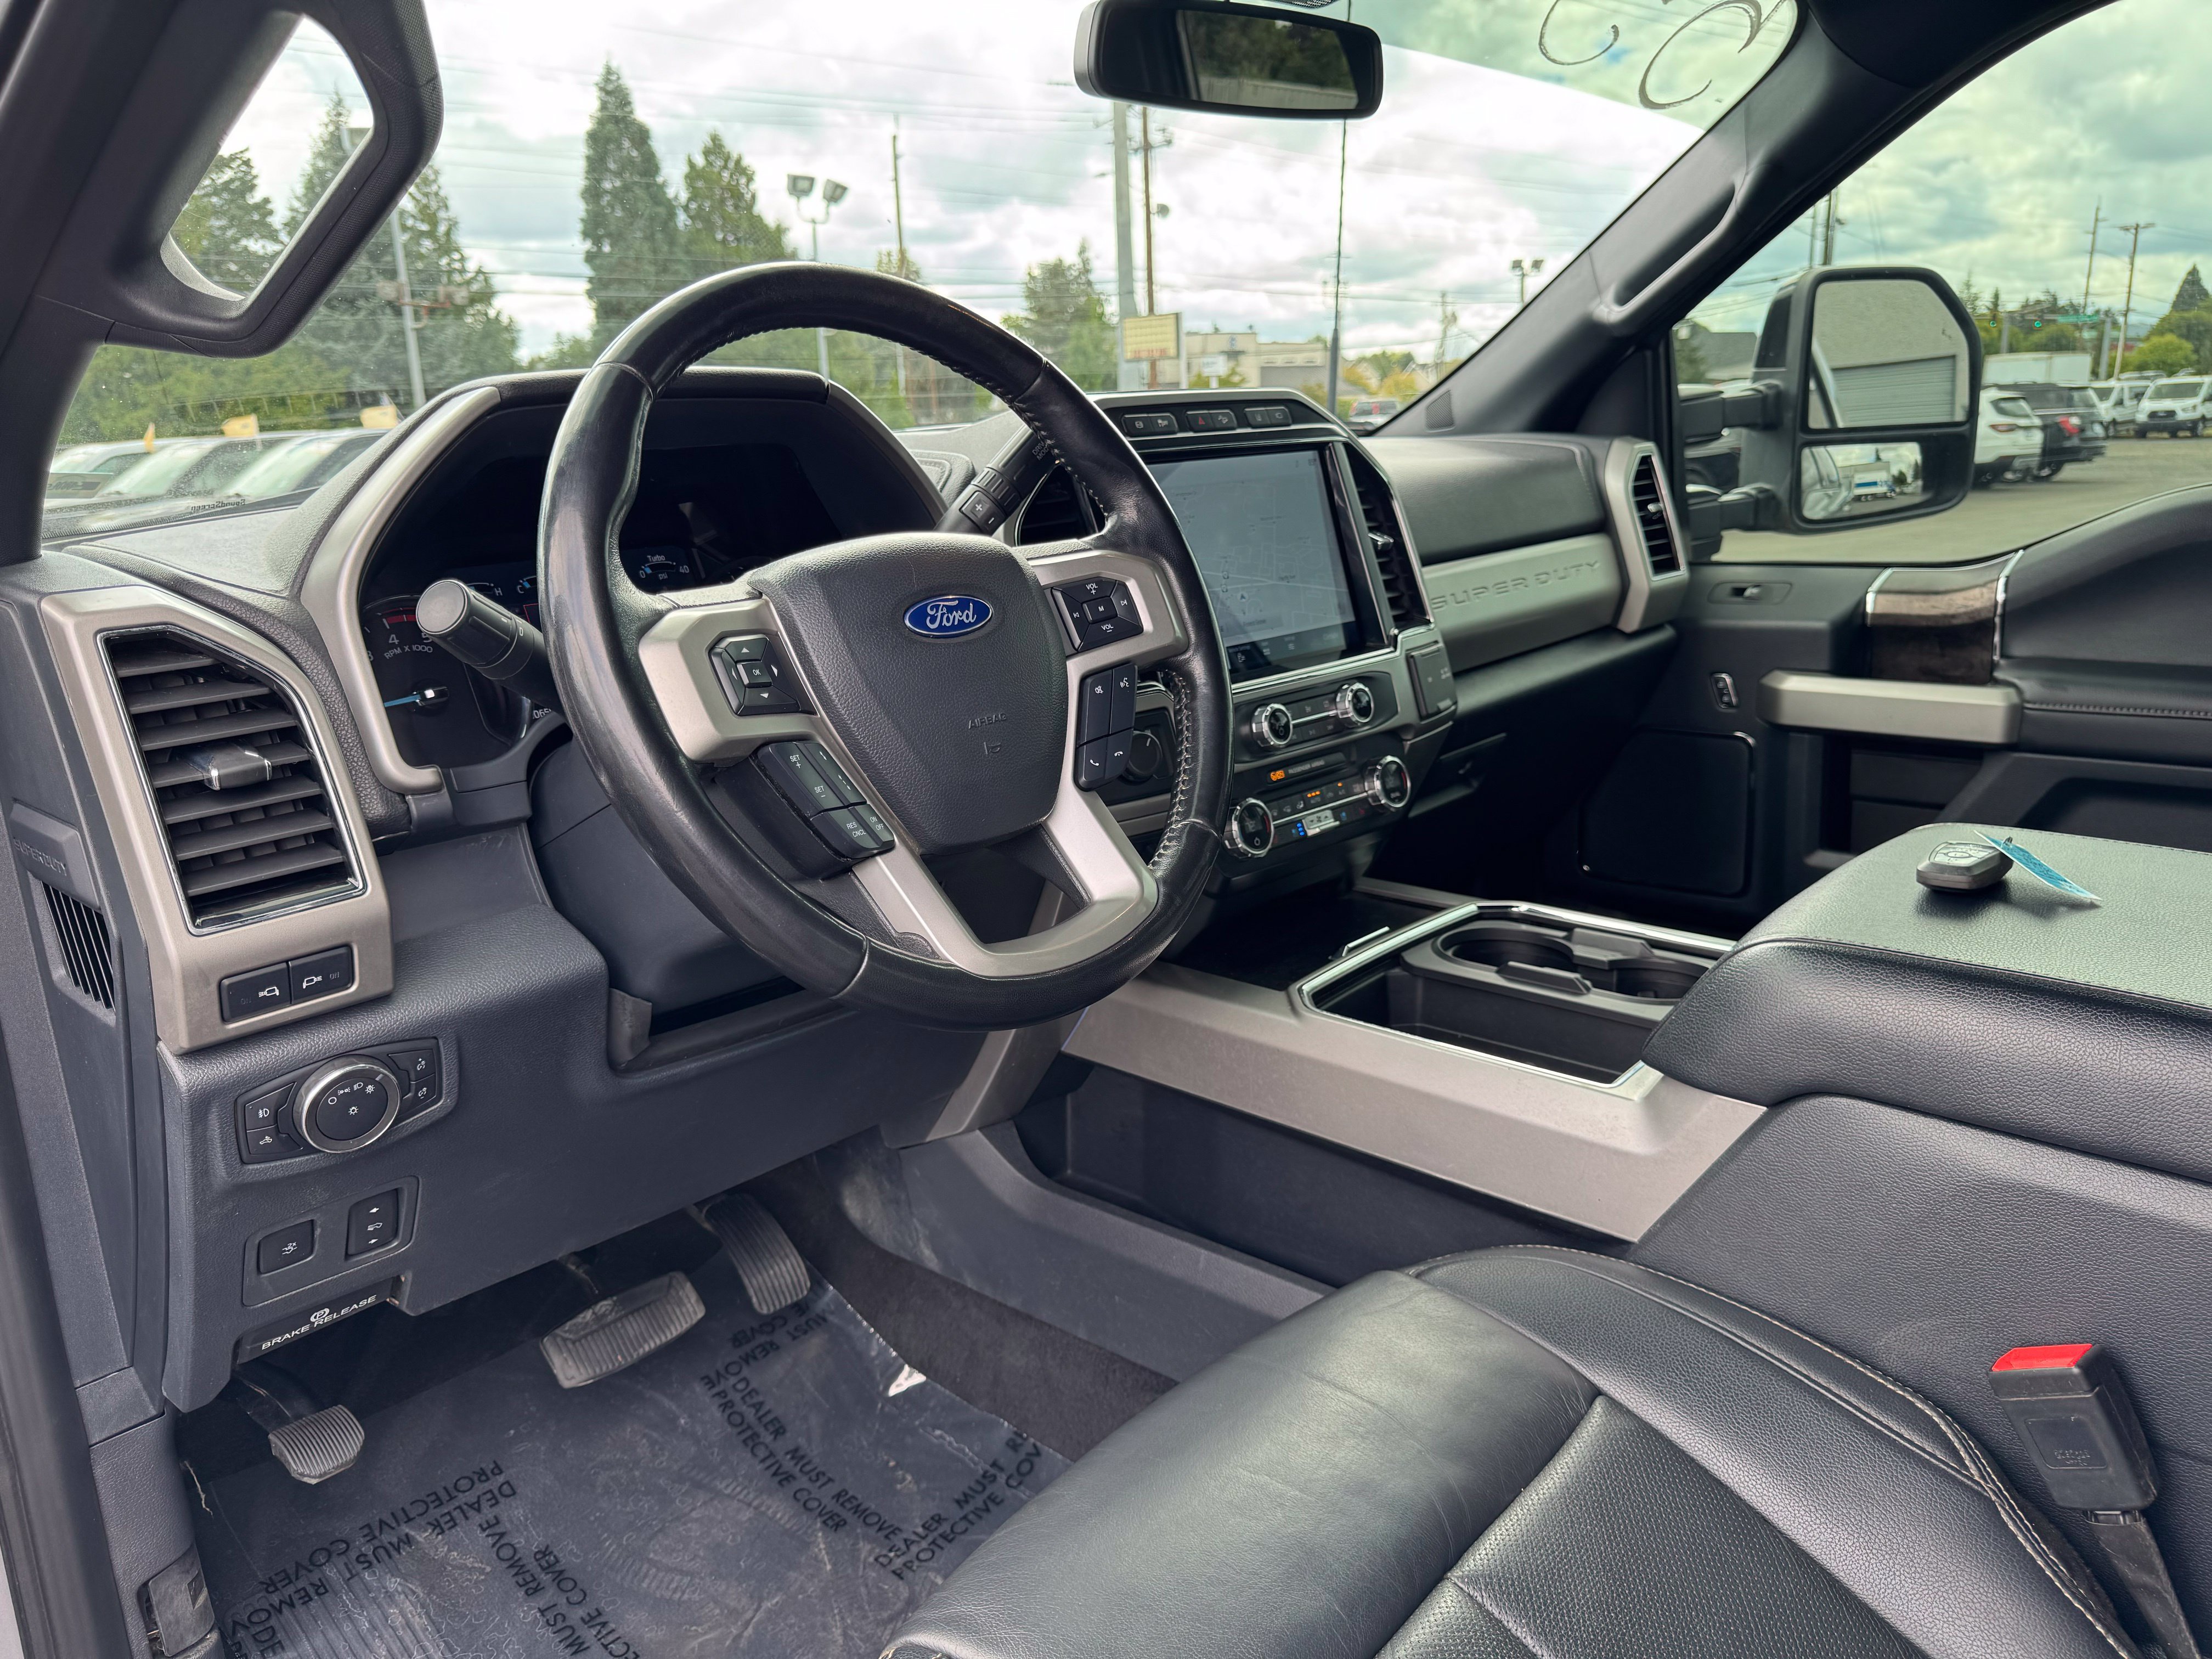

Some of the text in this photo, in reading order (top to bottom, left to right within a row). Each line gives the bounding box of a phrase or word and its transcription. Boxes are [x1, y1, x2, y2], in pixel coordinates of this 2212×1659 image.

[640, 565, 690, 578] 0 40
[647, 554, 665, 562] Turbo
[494, 587, 503, 596] H
[517, 585, 524, 594] C
[1430, 560, 1600, 611] SUPER DUTY
[388, 634, 399, 645] 4
[926, 600, 977, 629] Ford
[384, 648, 402, 659] RPM
[413, 645, 433, 653] 1000
[968, 713, 1007, 729] AIRBAG
[852, 829, 866, 837] CNCL
[262, 1294, 377, 1350] BRAKE RELEASE
[729, 1315, 788, 1348] COVER
[700, 1339, 781, 1391] REMOVE
[712, 1390, 847, 1532] PROTECTIVE COVER
[732, 1376, 902, 1541] DEALER MUST REMOVE
[258, 1459, 505, 1595] PROTECTIVE COVER
[874, 1458, 1005, 1568] DEALER MUST
[891, 1443, 1041, 1581] PROTECTIVE COV
[230, 1480, 517, 1637] DEALER MUST REMOV
[478, 1515, 590, 1656] MUST REMOVE
[533, 1544, 641, 1659] CTIVE COVER
